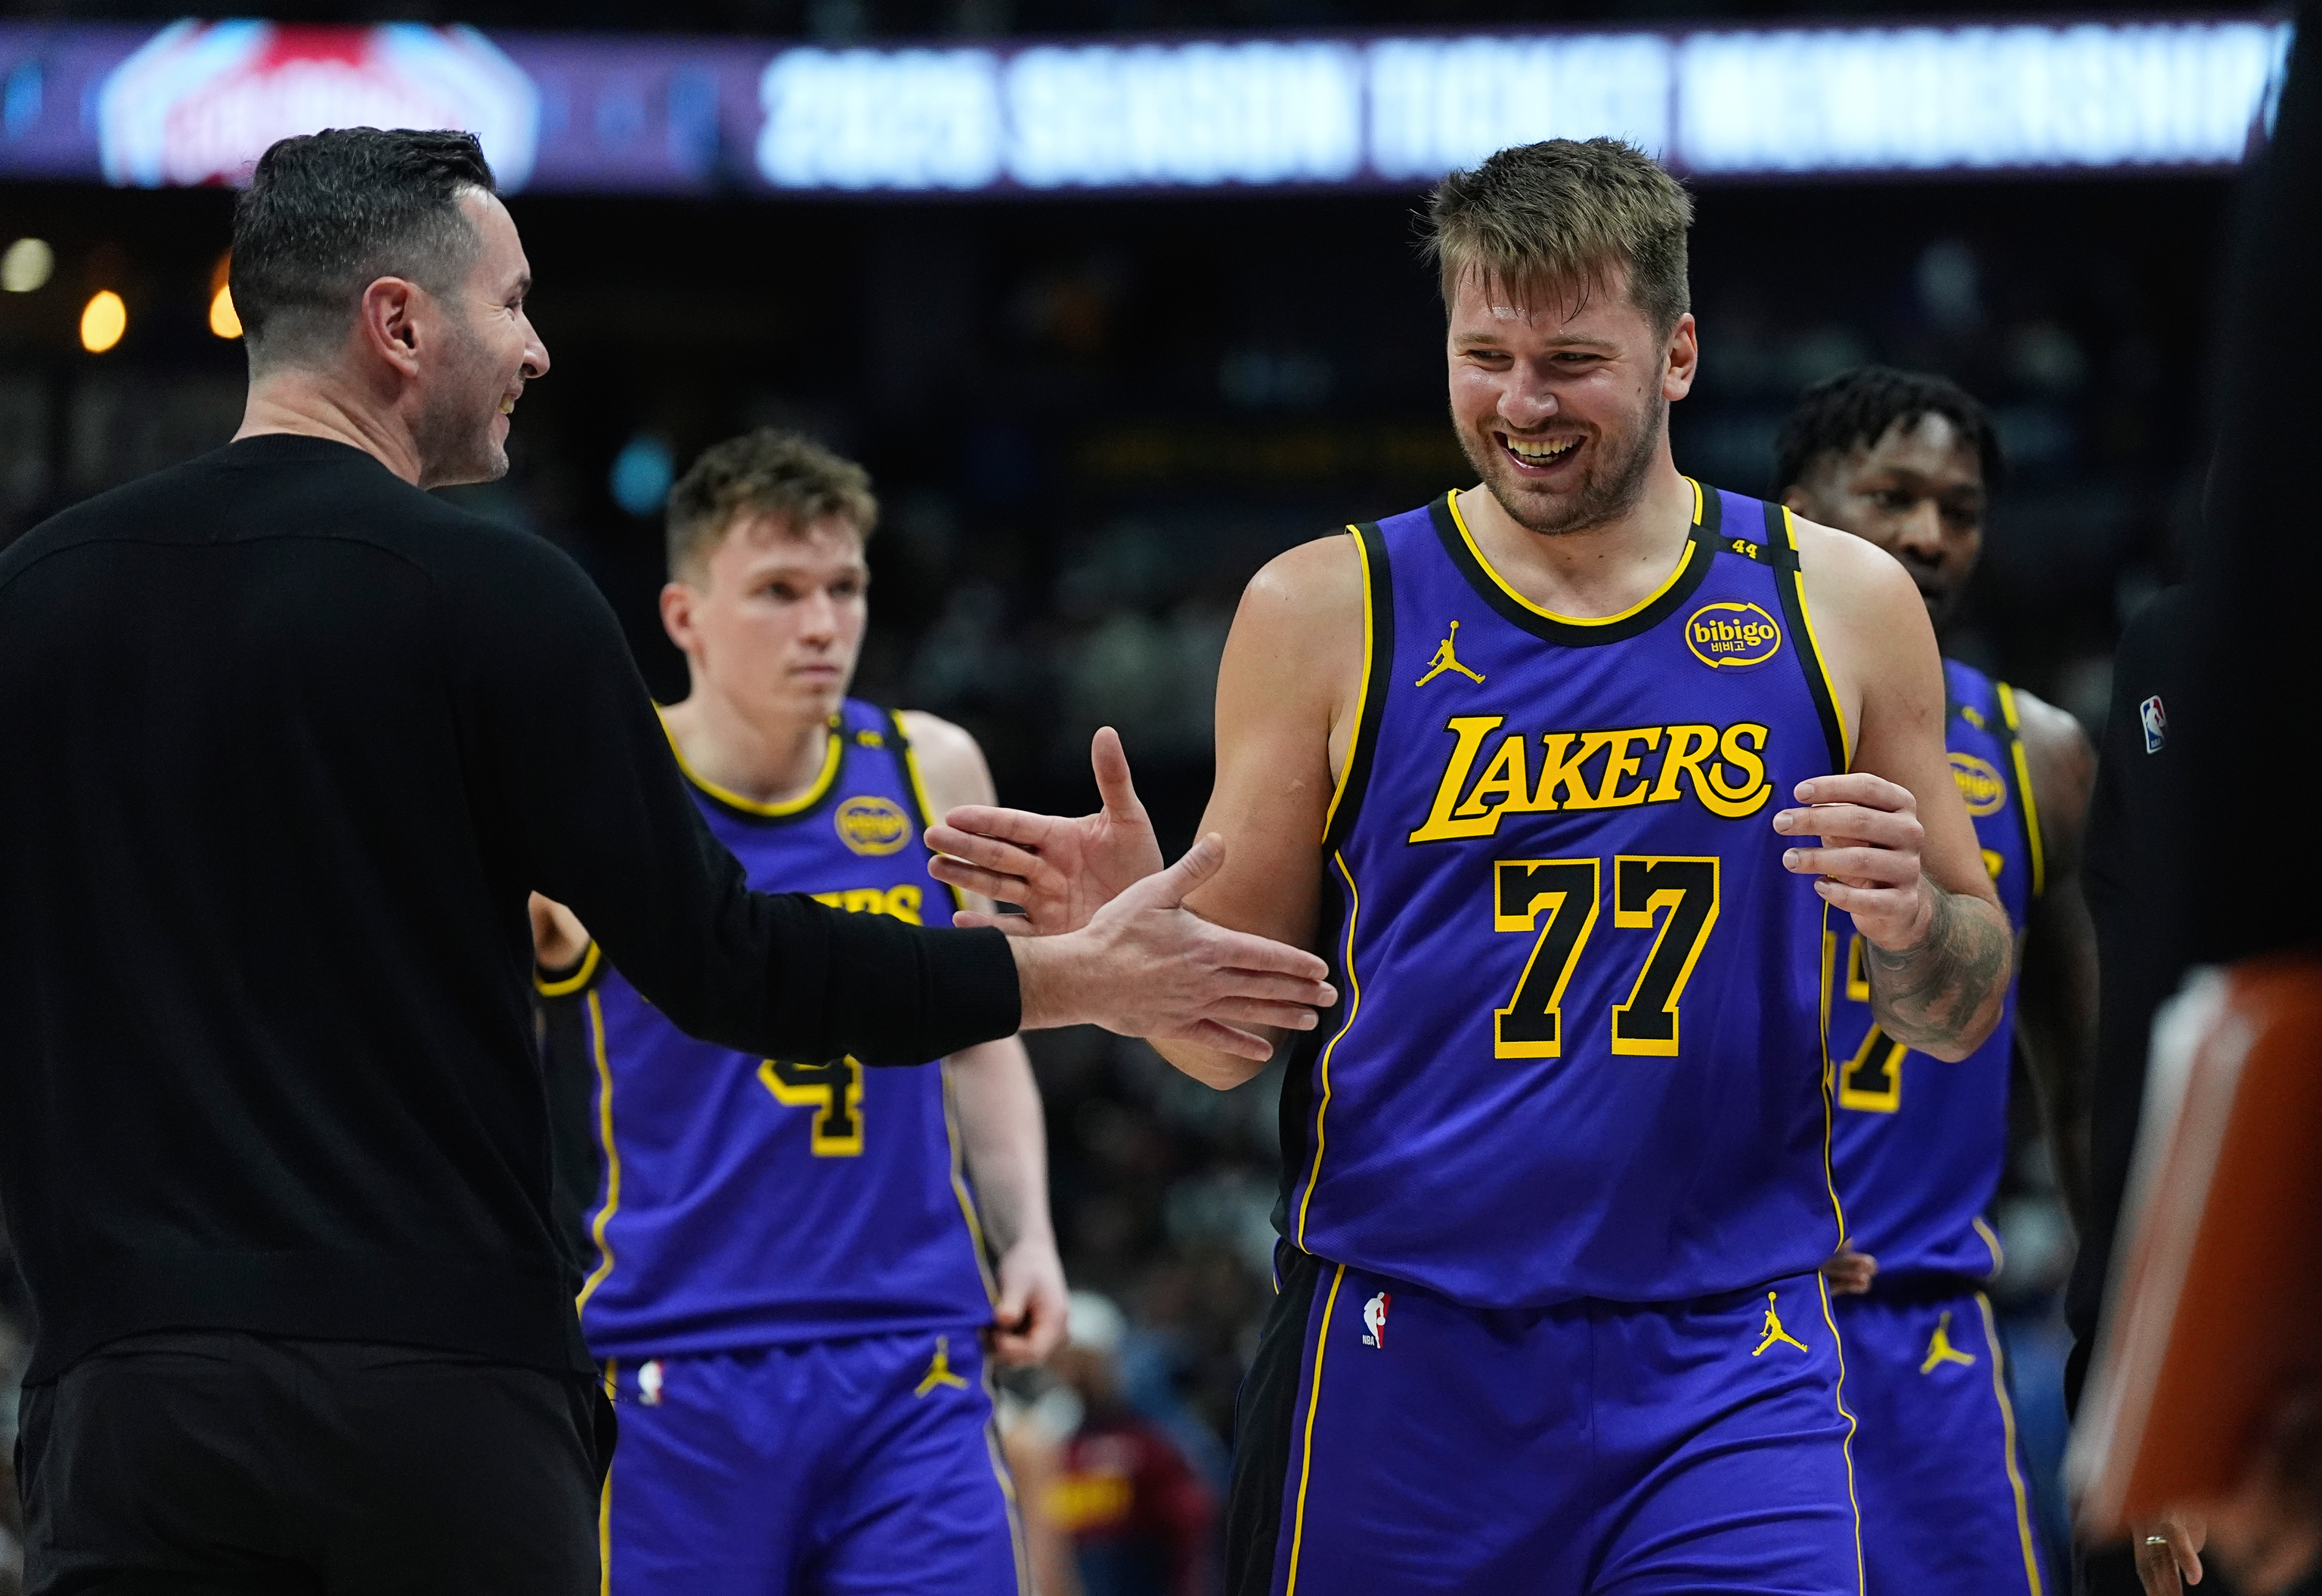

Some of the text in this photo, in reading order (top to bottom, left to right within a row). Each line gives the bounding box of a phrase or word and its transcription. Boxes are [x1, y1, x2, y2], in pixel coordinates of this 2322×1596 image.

[1005, 43, 1361, 187] SEASON
[1732, 539, 1758, 559] 44
[1694, 618, 1775, 646] bibigo
[1711, 641, 1746, 653] 비비고
[1407, 715, 1772, 845] LAKERS
[1494, 855, 1720, 1058] 77
[1362, 1335, 1374, 1345] NBA
